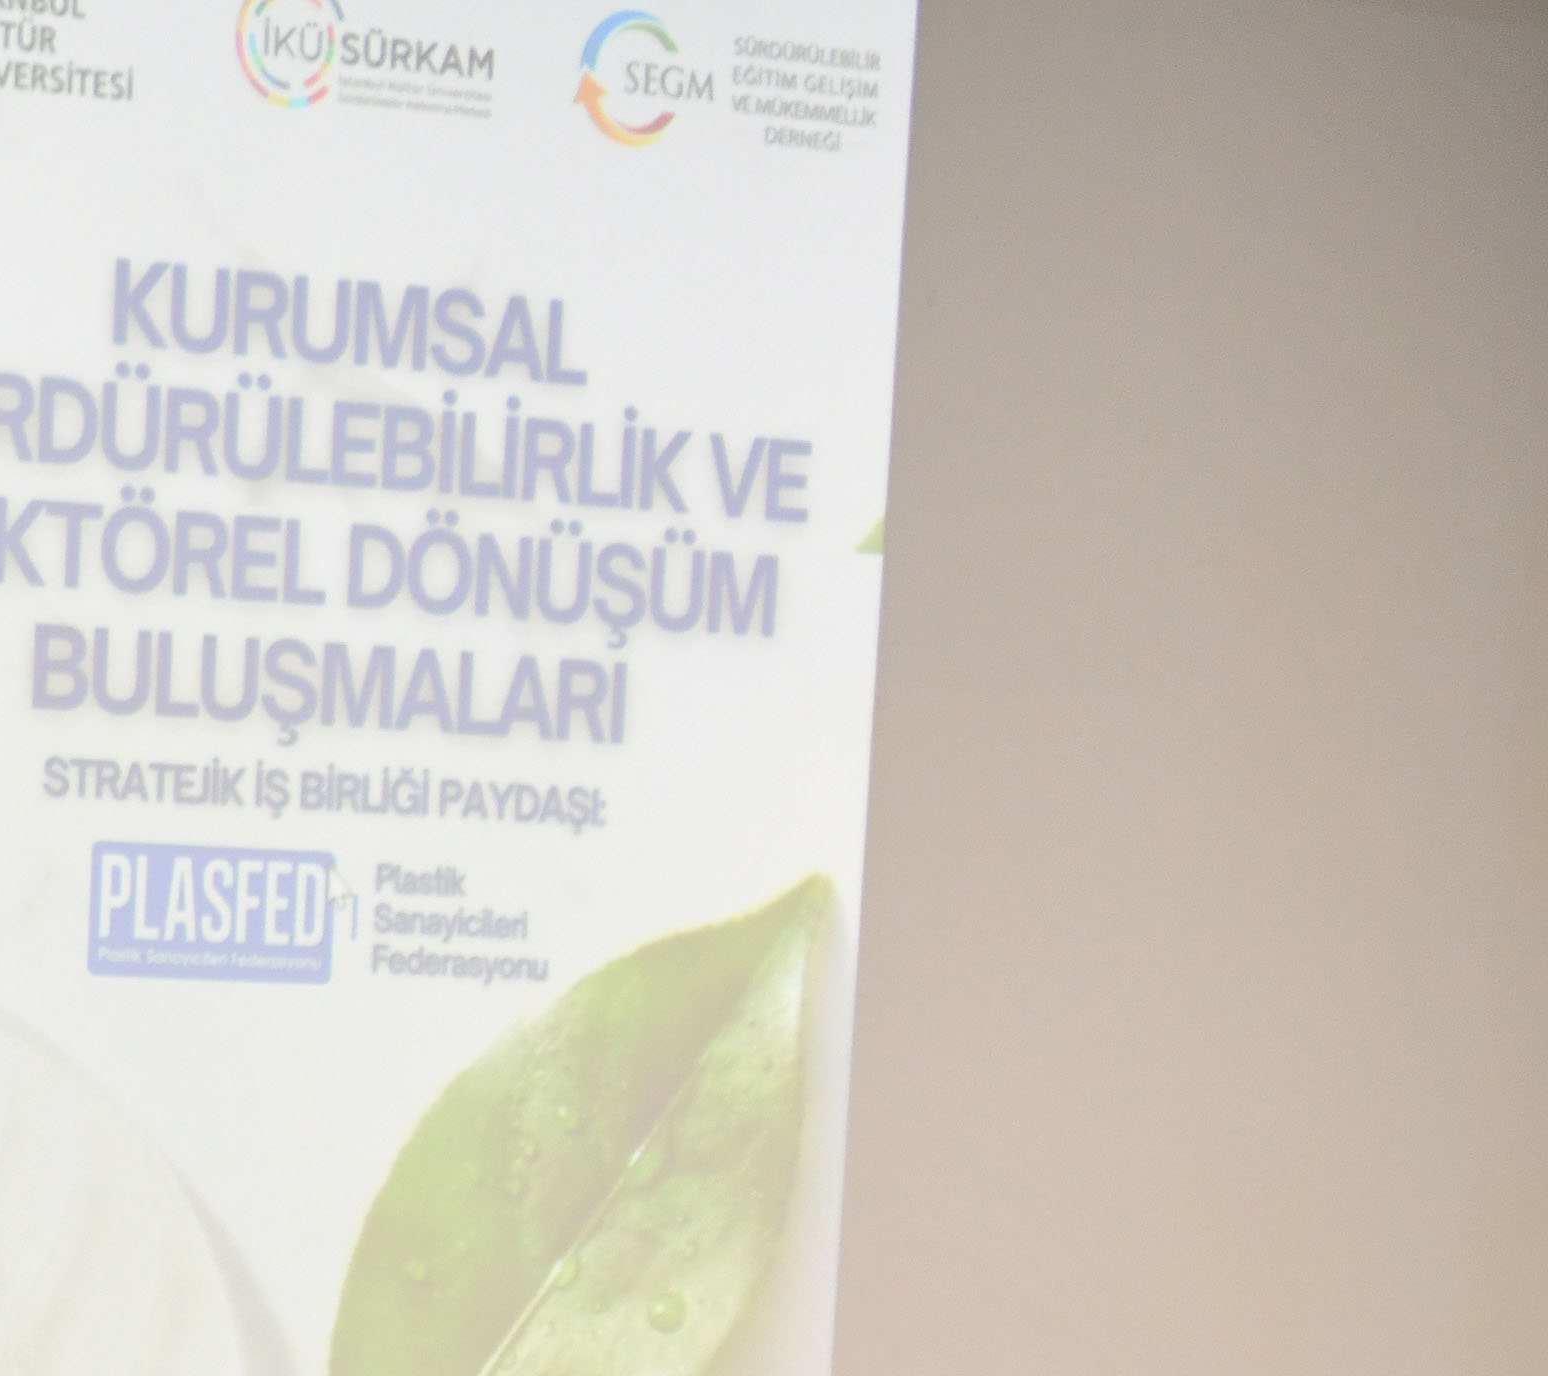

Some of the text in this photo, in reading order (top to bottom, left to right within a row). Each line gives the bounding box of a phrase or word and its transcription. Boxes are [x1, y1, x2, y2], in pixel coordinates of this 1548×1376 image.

[263, 17, 495, 80] İKÜ SÜRKAM
[625, 61, 715, 102] SEGM
[732, 94, 751, 114] VE
[112, 258, 588, 387] KURUMSAL
[709, 432, 813, 524] VE
[346, 507, 780, 651] DÖNÜŞÜM
[31, 622, 628, 745] BULUŞMALARI
[42, 755, 246, 807] STRATEJİK
[254, 761, 291, 817] İŞ
[299, 765, 430, 817] BİRLİĞİ
[99, 853, 327, 947] PLASFED
[375, 862, 466, 897] Plastik
[371, 943, 549, 984] Federasyonu
